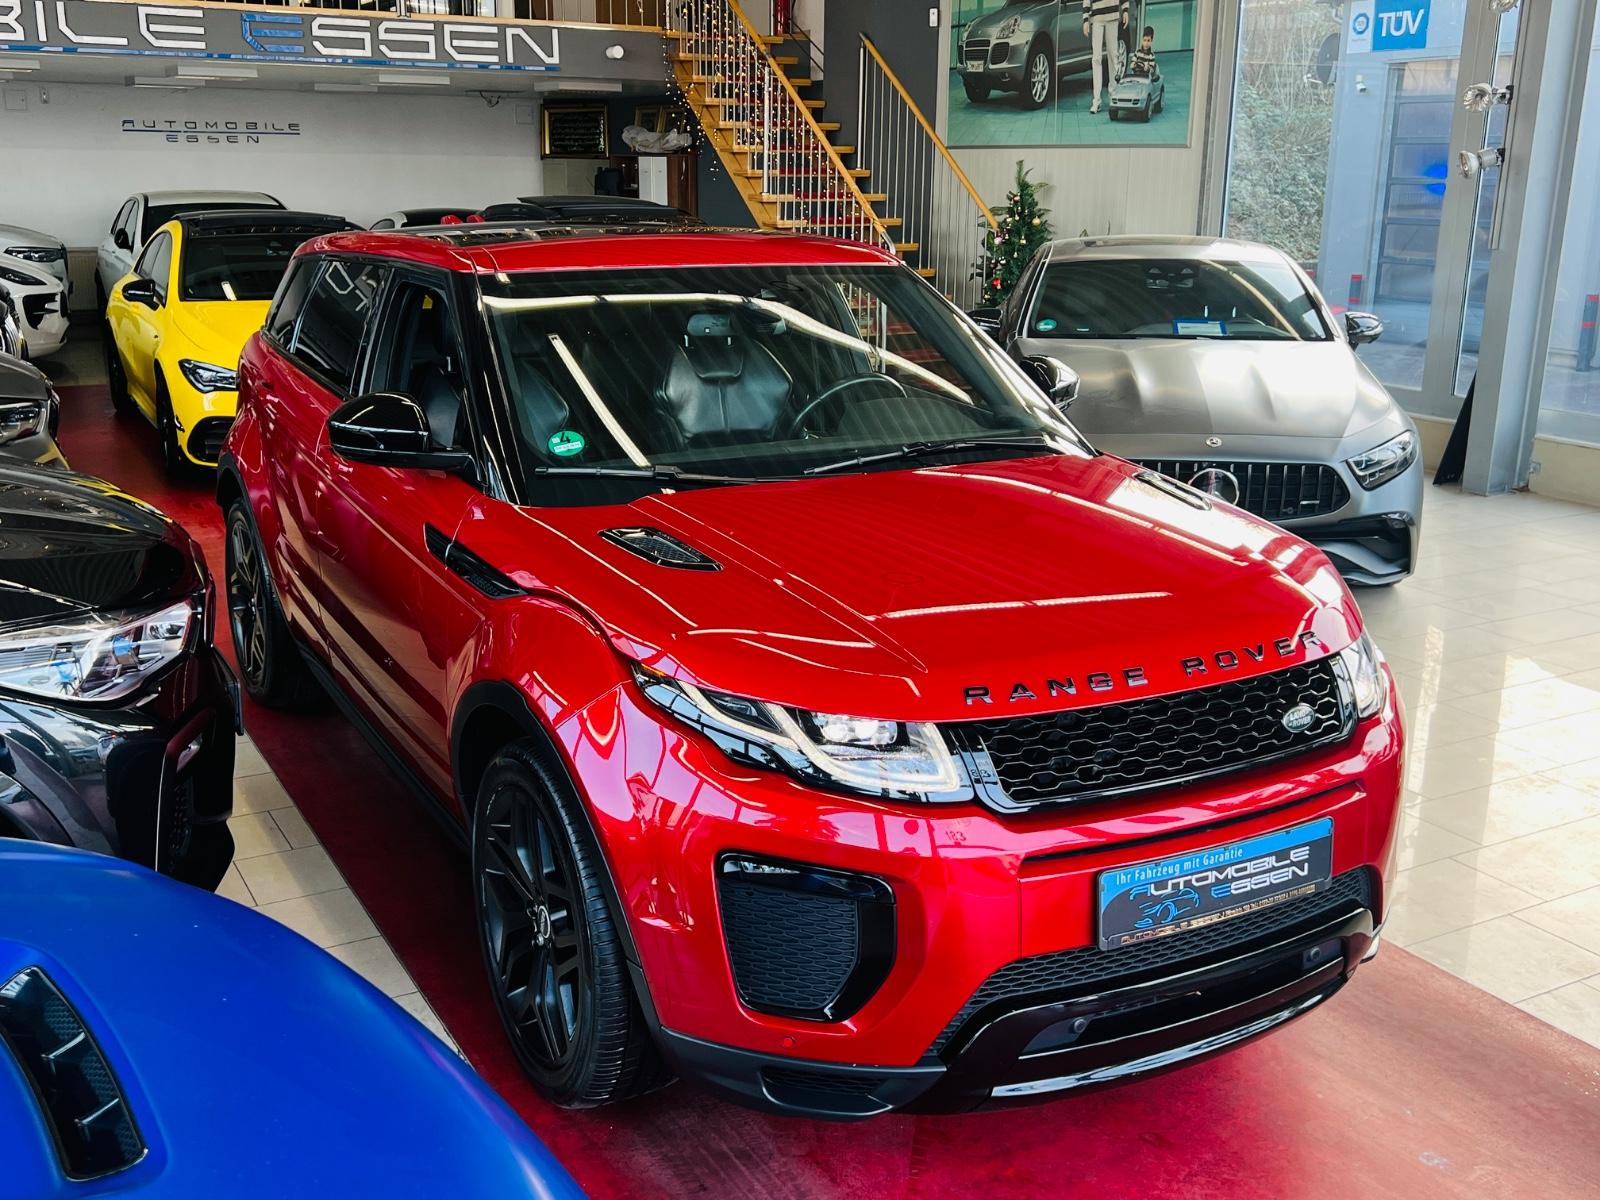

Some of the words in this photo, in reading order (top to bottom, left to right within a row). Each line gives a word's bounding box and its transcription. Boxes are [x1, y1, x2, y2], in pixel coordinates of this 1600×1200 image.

[241, 12, 560, 65] ESSEN
[1378, 8, 1425, 37] TÜV
[122, 119, 301, 131] AUTOMOBILE
[165, 134, 260, 144] ESSEN
[561, 432, 570, 443] 4
[964, 666, 1148, 706] RANGE
[1183, 631, 1321, 675] ROVER
[1290, 710, 1306, 720] LAND
[1116, 873, 1132, 886] Ihr
[1134, 864, 1181, 883] Fahrzeug
[1183, 859, 1200, 873] mit
[1203, 847, 1244, 866] Garantie
[1129, 845, 1310, 900] AUTOMOBILE
[1211, 862, 1309, 899] ESSEN
